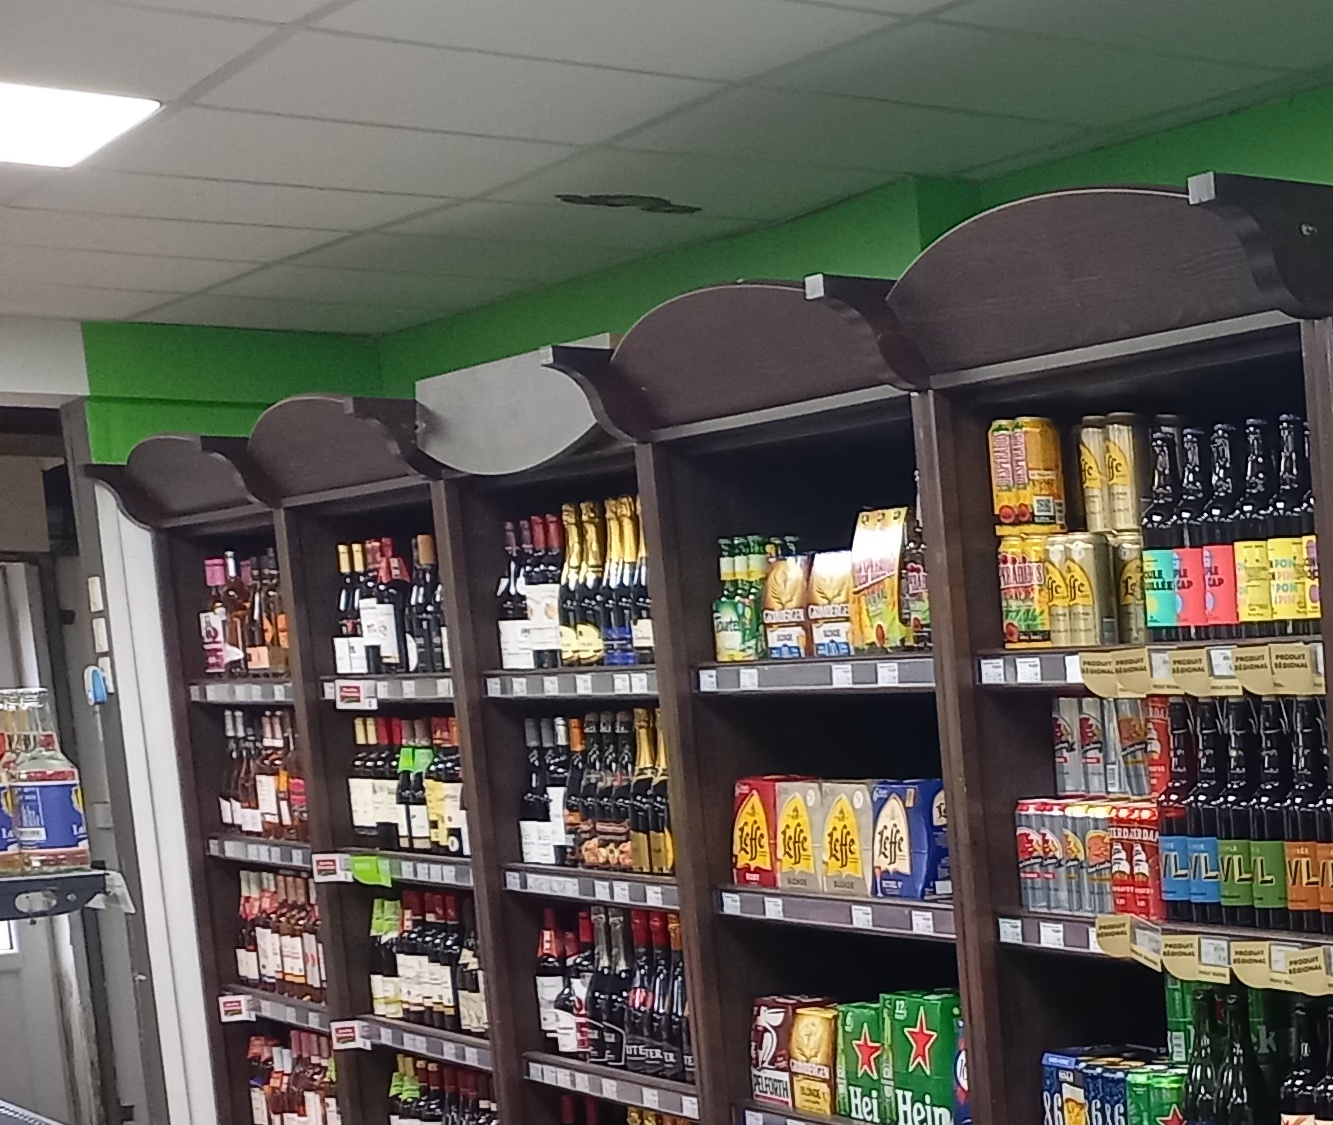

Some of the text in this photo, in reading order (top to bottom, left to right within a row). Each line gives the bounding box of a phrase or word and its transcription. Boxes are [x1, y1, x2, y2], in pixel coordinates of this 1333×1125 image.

[1275, 653, 1306, 661] PRODUIT
[738, 820, 765, 861] Leffe
[781, 822, 808, 865] Leffe
[827, 824, 856, 868] Leffe
[878, 823, 904, 865] Leffe
[1234, 950, 1264, 958] PRODUIT
[753, 1074, 789, 1099] PELFORTH
